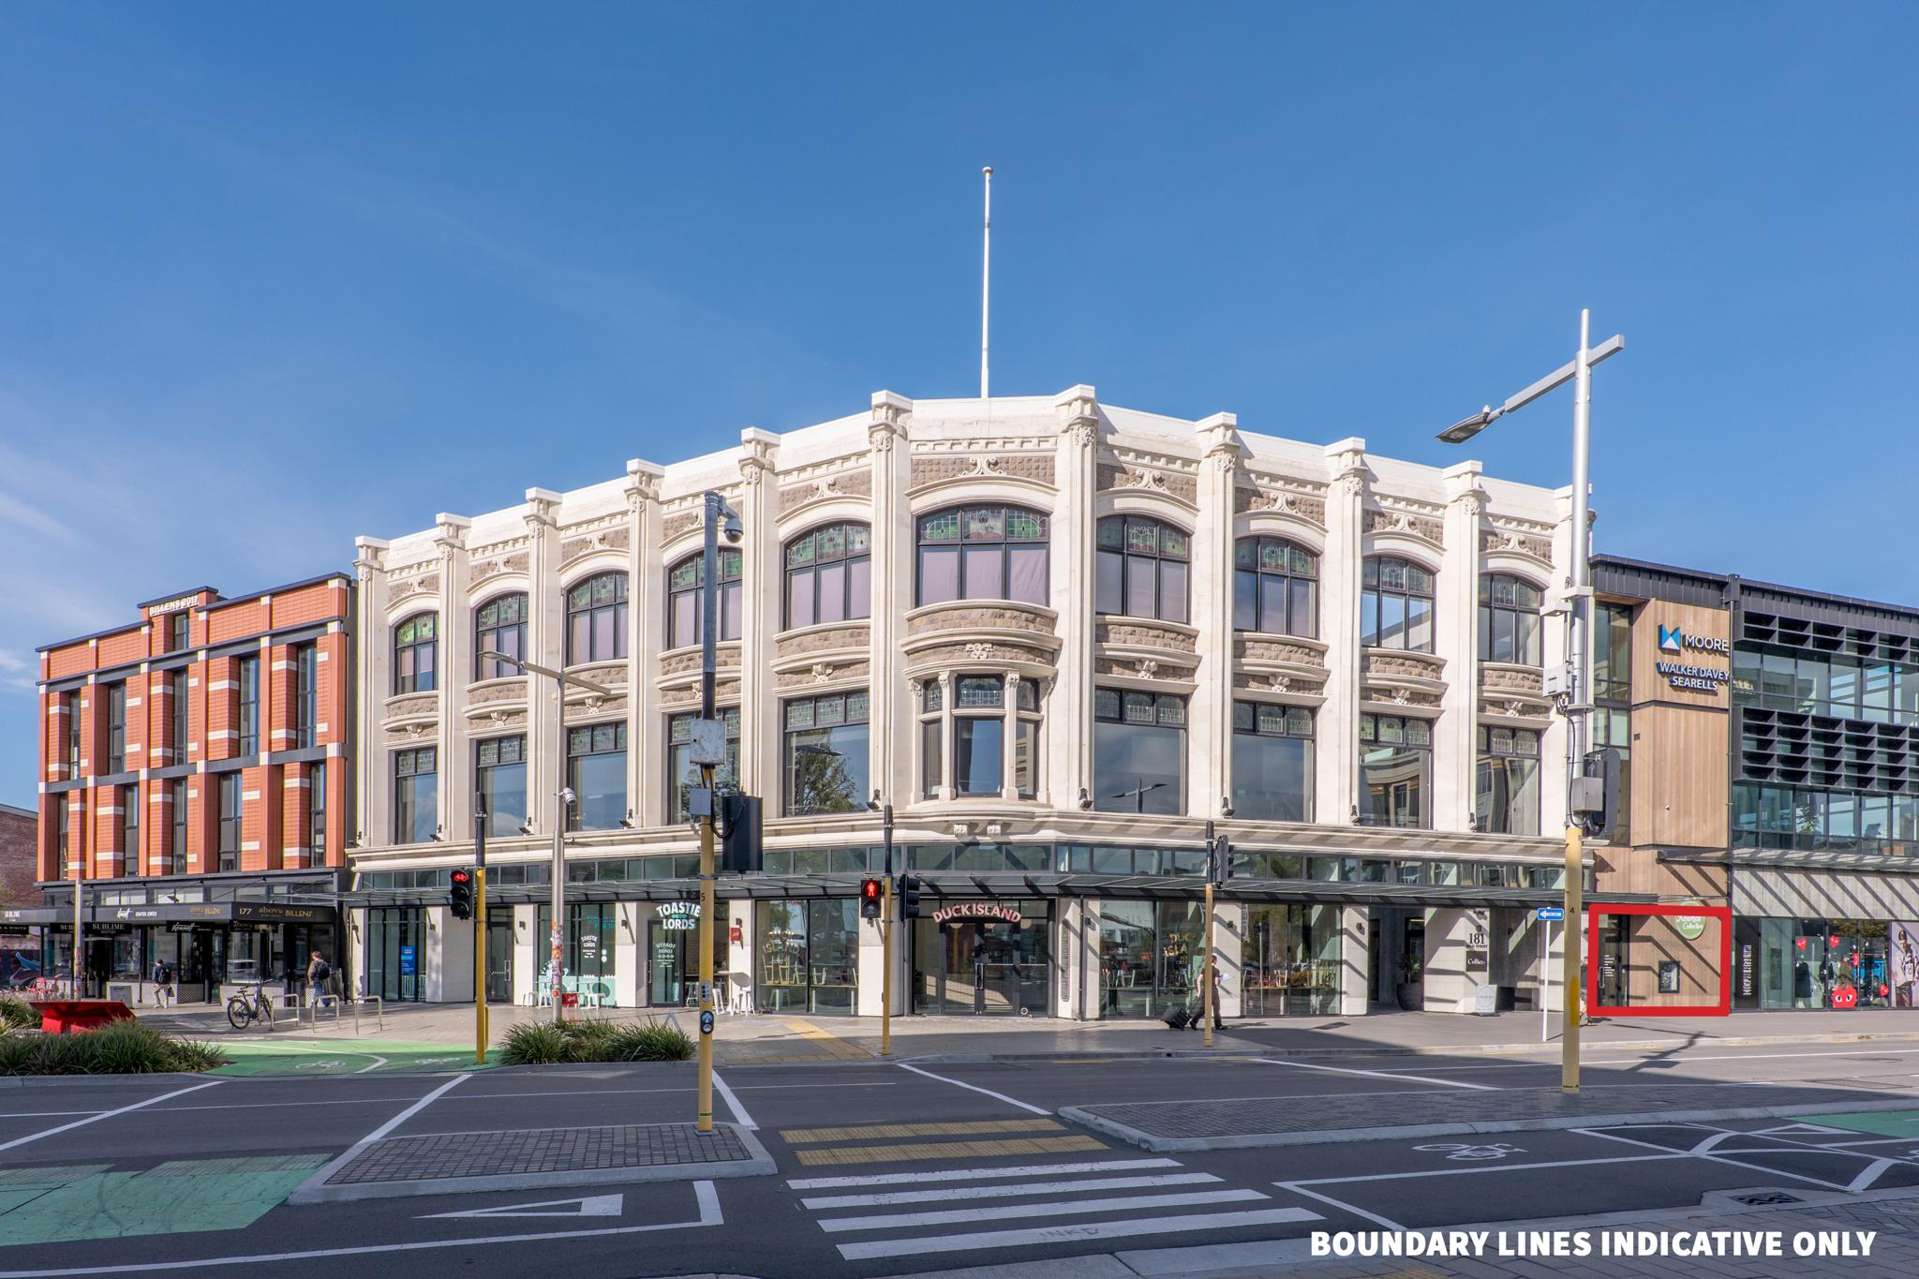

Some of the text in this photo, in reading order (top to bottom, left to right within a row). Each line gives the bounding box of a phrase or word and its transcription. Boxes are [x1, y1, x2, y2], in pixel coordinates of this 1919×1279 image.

[1685, 634, 1729, 651] MOORE
[1660, 662, 1729, 680] WALKER DAVEY
[1672, 676, 1718, 690] SEARELLS
[656, 902, 701, 917] TOASTIE
[932, 904, 1021, 923] DUCK ISLAND
[662, 919, 697, 930] LORDS
[1469, 933, 1486, 945] 181
